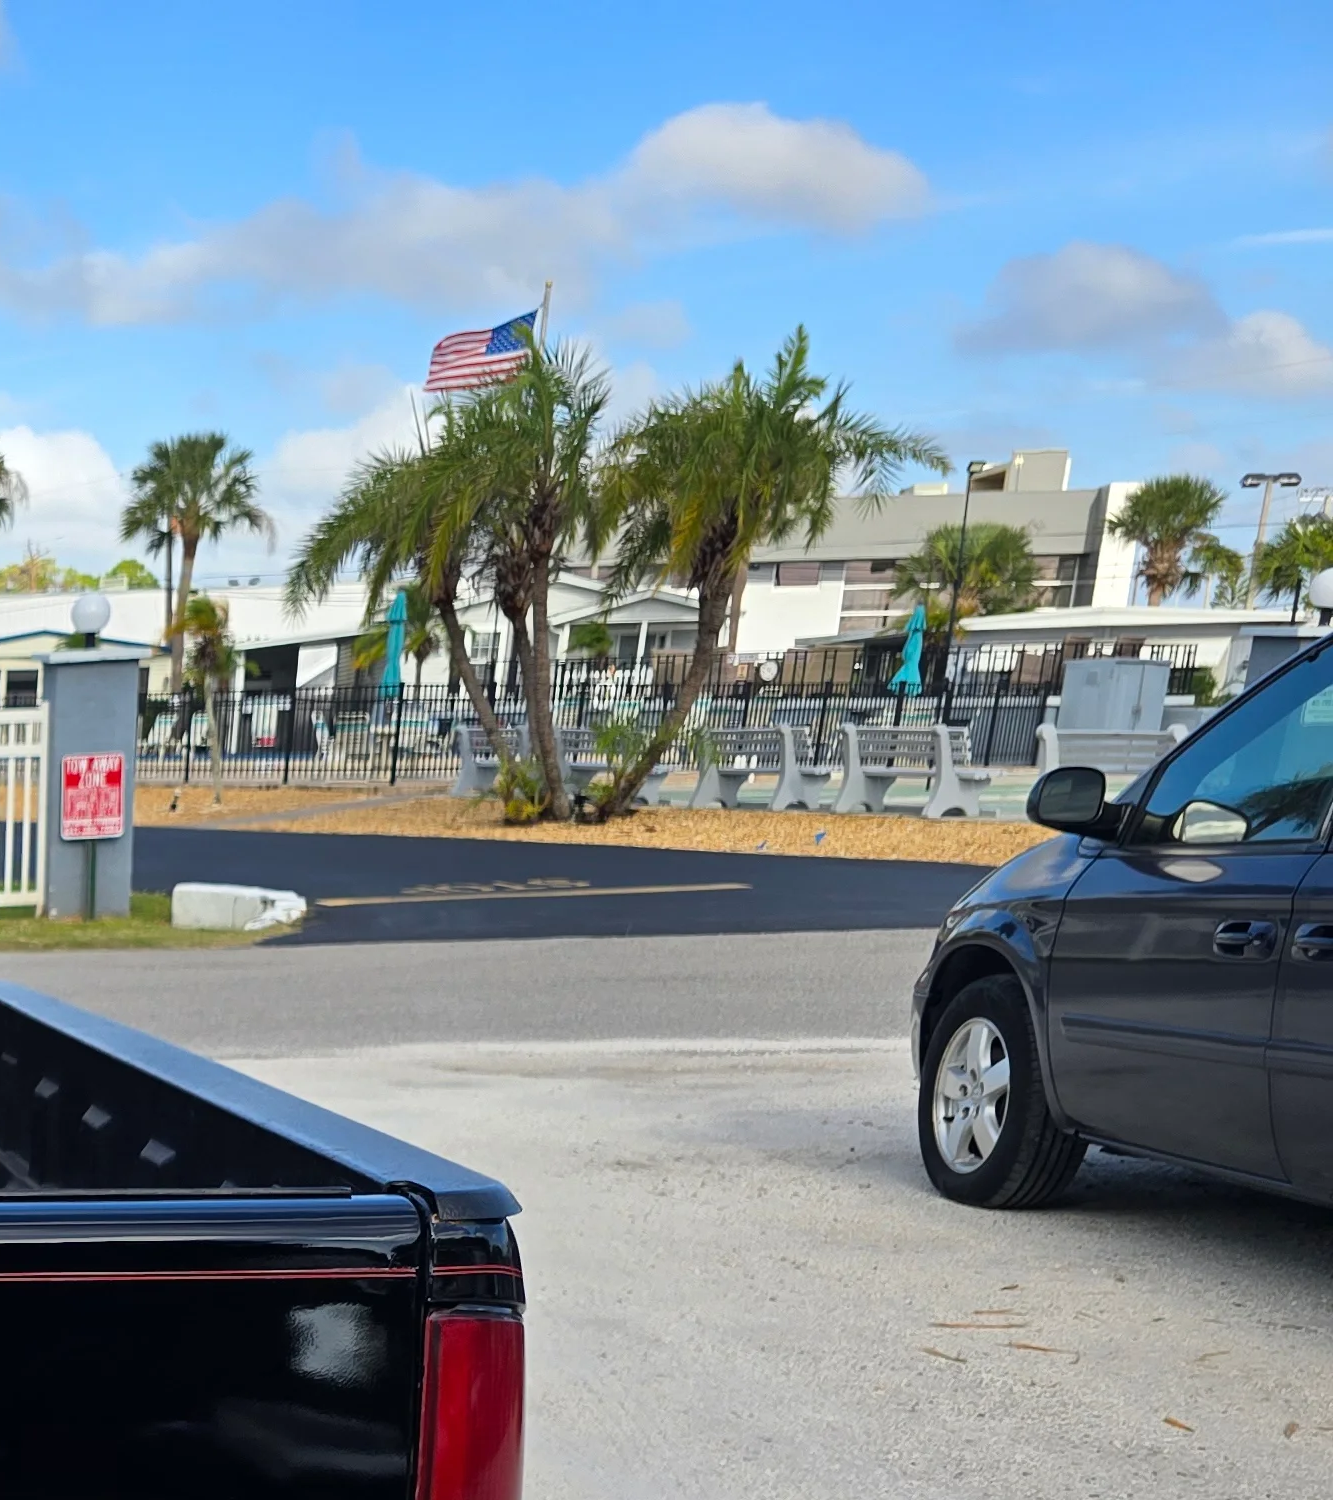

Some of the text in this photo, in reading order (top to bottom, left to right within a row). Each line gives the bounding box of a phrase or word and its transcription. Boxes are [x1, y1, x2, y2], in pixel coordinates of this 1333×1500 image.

[66, 757, 120, 774] TOW AWAY
[78, 771, 107, 788] ZONE
